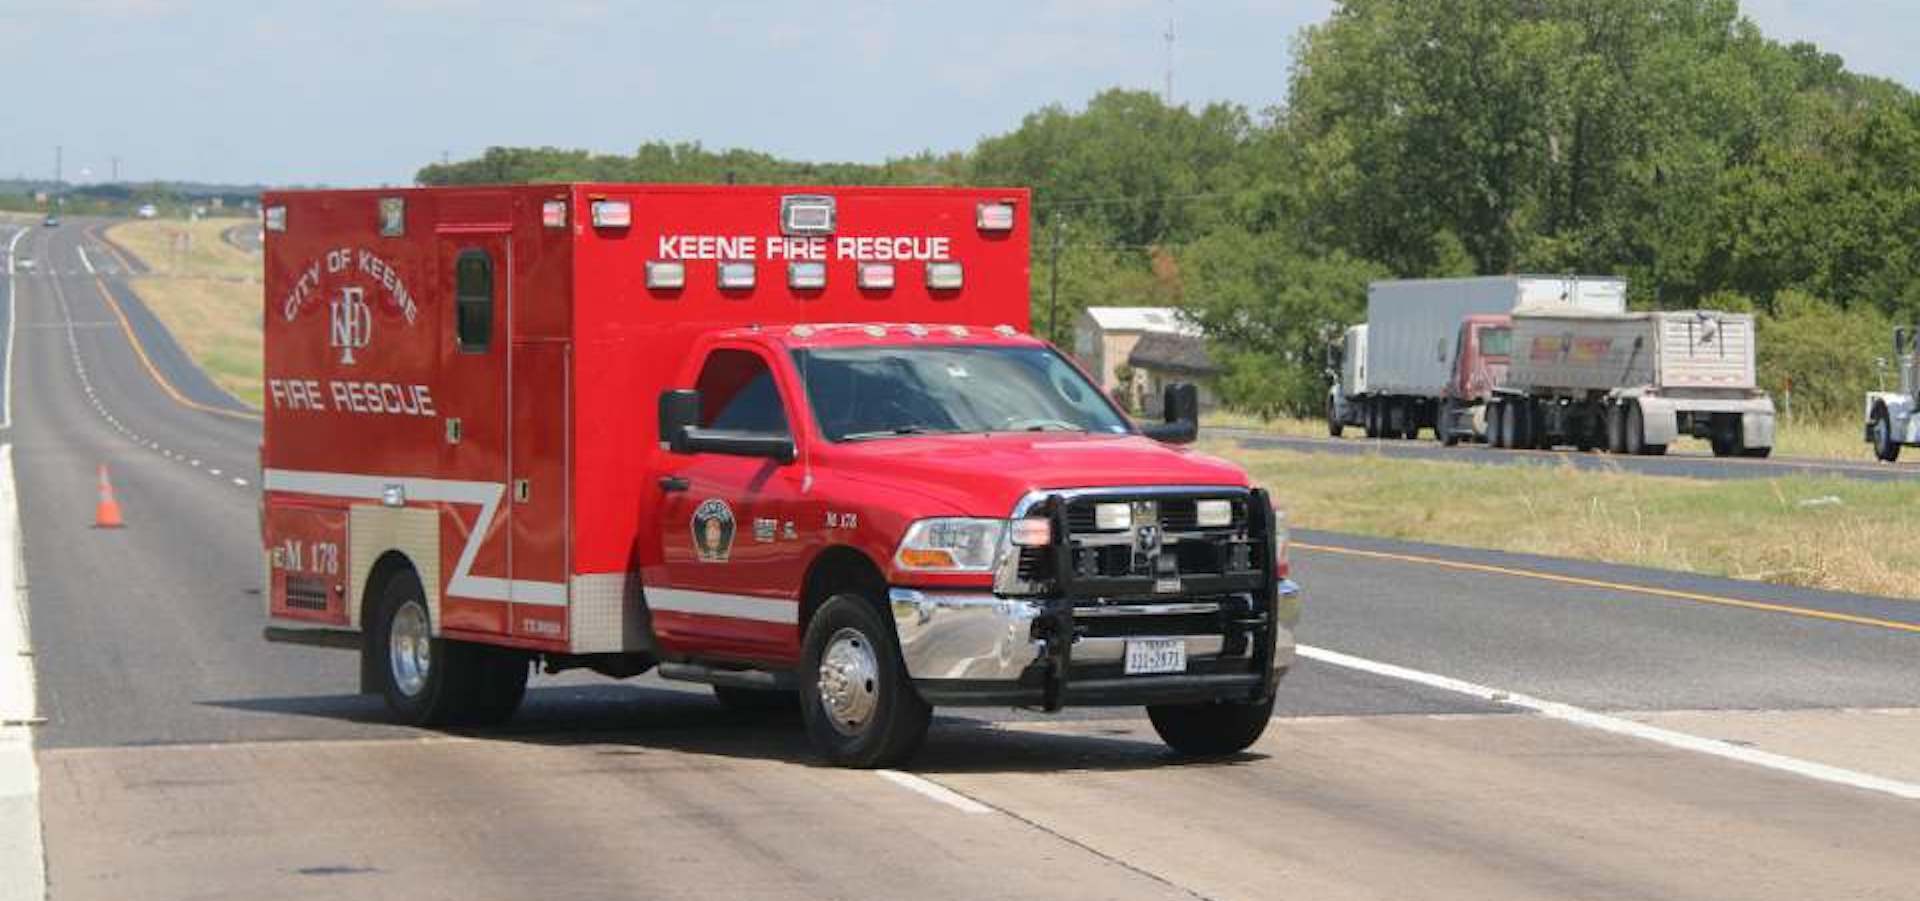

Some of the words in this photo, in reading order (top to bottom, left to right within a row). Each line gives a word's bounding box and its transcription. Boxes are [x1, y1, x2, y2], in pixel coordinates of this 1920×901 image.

[659, 236, 755, 259] KEENE
[767, 237, 825, 260] FIRE
[837, 237, 950, 260] RESCUE
[285, 259, 320, 321] CITY
[327, 249, 351, 273] OF
[358, 249, 416, 325] KEENE
[270, 379, 325, 410] FIRE
[329, 381, 436, 416] RESCUE
[825, 512, 837, 528] M
[285, 539, 303, 572] M
[311, 542, 338, 575] 178
